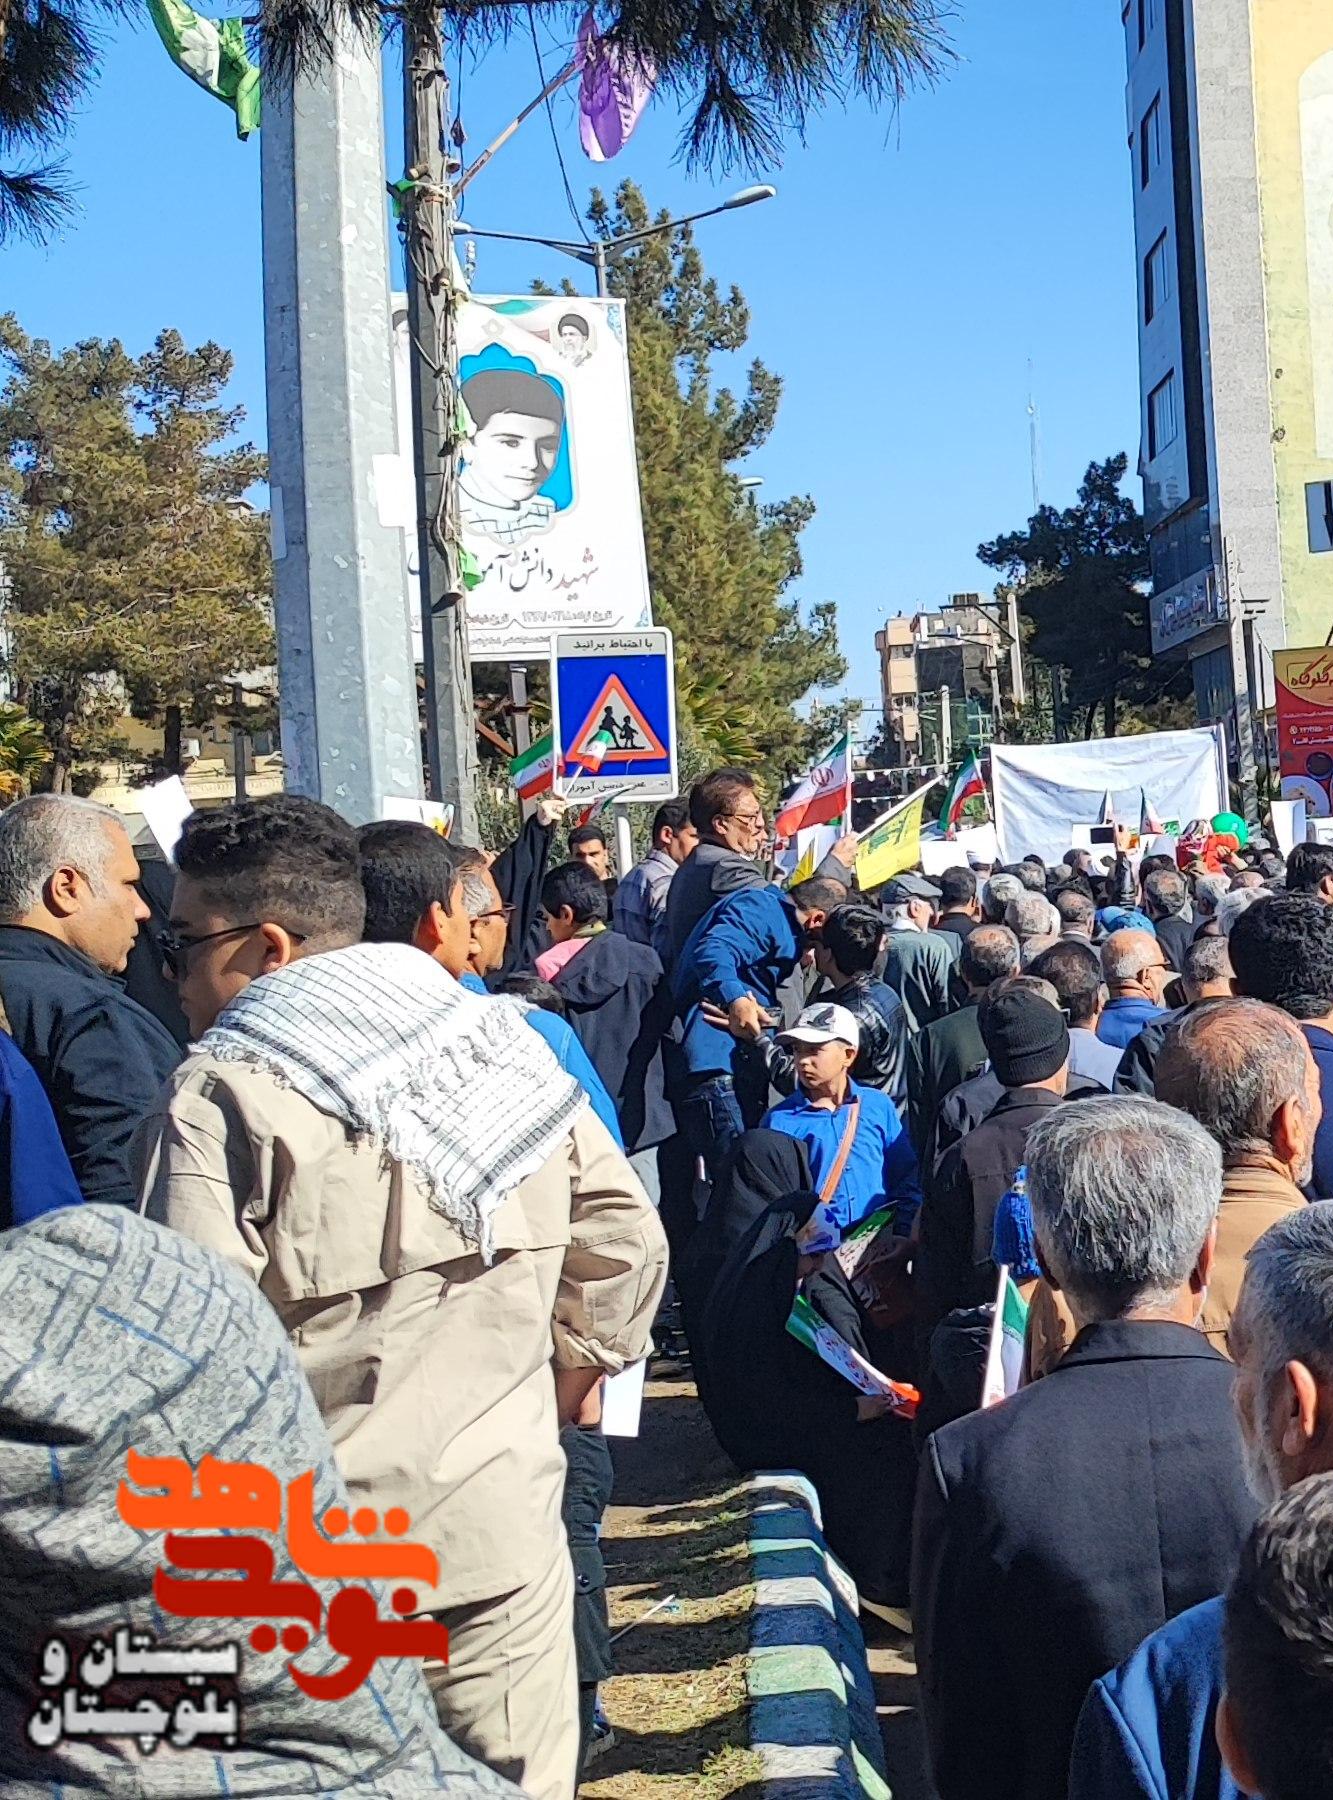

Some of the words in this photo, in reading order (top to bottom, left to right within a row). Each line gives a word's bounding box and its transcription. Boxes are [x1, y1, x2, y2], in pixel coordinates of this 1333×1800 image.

[510, 547, 553, 592] دانش
[551, 547, 600, 602] شهید
[572, 639, 606, 652] برانید
[608, 638, 643, 651] احتیاط
[644, 638, 653, 651] با
